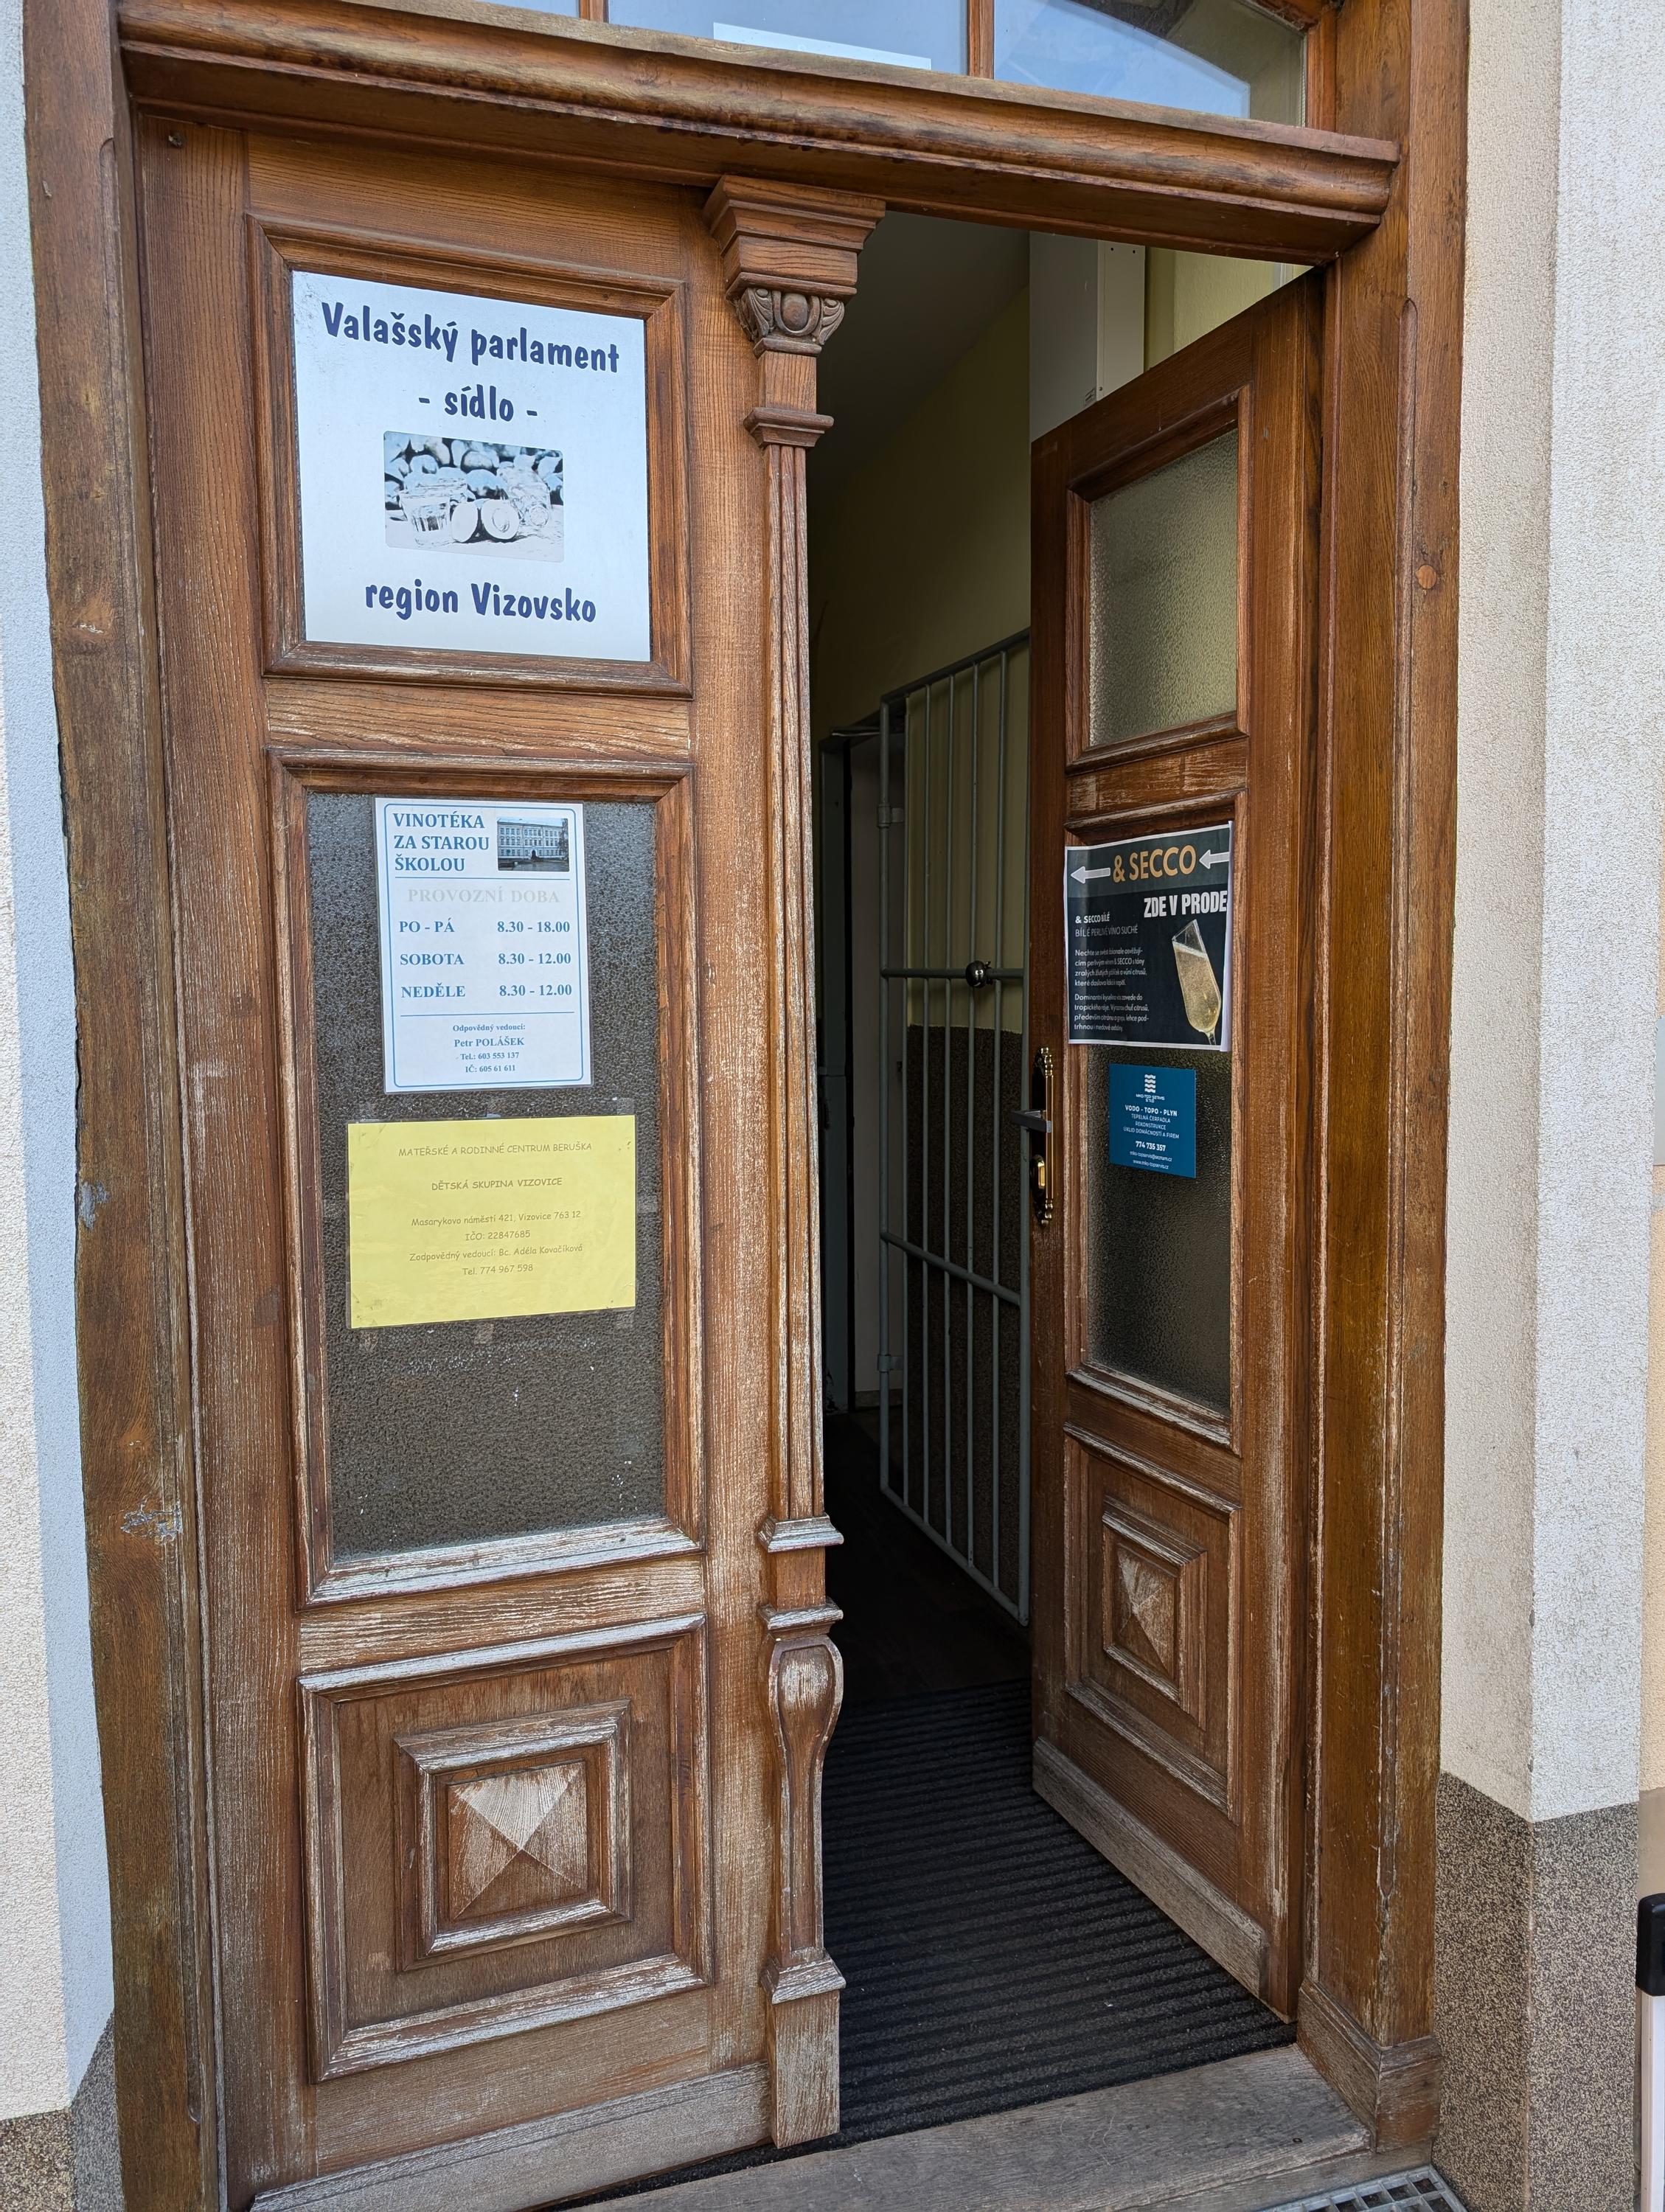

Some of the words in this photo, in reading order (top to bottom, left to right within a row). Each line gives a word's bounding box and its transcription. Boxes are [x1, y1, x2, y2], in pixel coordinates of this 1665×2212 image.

[321, 302, 459, 363] Valašský
[471, 327, 619, 372] parlament
[444, 385, 514, 422] sídlo
[366, 579, 459, 620] region
[471, 582, 597, 622] Vizovsko
[393, 811, 485, 829] VINOTÉKA
[394, 835, 417, 849] ZA
[422, 836, 490, 850] STAROU
[394, 854, 465, 872] ŠKOLOU
[1113, 855, 1125, 883] &
[1129, 845, 1197, 880] SECCO
[408, 886, 503, 902] PROVOZNÍ
[512, 890, 559, 903] DOBA
[1144, 897, 1167, 917] ZDE
[1169, 895, 1178, 916] V
[400, 921, 420, 933] PO
[434, 917, 454, 932] PÁ
[497, 921, 524, 933] 8.30
[537, 921, 570, 933] 18.00
[1084, 915, 1100, 923] SECCO
[1075, 928, 1090, 936] BÍLÉ
[1108, 925, 1121, 935] VÍNO
[1121, 923, 1139, 934] SUCHÉ
[400, 953, 465, 965] SOBOTA
[498, 953, 525, 964] 8.30
[539, 953, 571, 964] 12.00
[1075, 969, 1094, 978] zralých
[401, 982, 466, 998] NEDĚLE
[499, 985, 526, 997] 8.30
[539, 985, 572, 996] 12.00
[453, 1024, 494, 1032] Odpovědný
[476, 1036, 524, 1046] POLÁŠEK
[1136, 1121, 1166, 1130] REKONSTRUKCE
[1150, 1115, 1170, 1123] ČERPADLA
[1136, 1128, 1162, 1136] DOMÁCNOSTÍ
[398, 1144, 448, 1156] MATEŘSKÉ
[461, 1143, 504, 1154] RODINNÉ
[507, 1144, 550, 1152] CENTRUM
[553, 1141, 591, 1152] BERUŠKA
[1146, 1142, 1155, 1150] 735
[432, 1180, 468, 1190] DĚTSKÁ
[473, 1180, 513, 1189] SKUPINA
[518, 1178, 562, 1186] VIZOVICE
[411, 1217, 462, 1227] Masarykovo
[464, 1215, 496, 1224] náměstí
[498, 1214, 516, 1222] 421,
[555, 1211, 569, 1220] 763
[465, 1231, 485, 1240] IČO:
[488, 1230, 531, 1239] 22847685
[463, 1249, 496, 1258] vedoucí:
[498, 1248, 510, 1256] Bc.
[514, 1247, 537, 1255] Adéla
[540, 1244, 583, 1253] Kovačíková
[481, 1266, 496, 1274] 774
